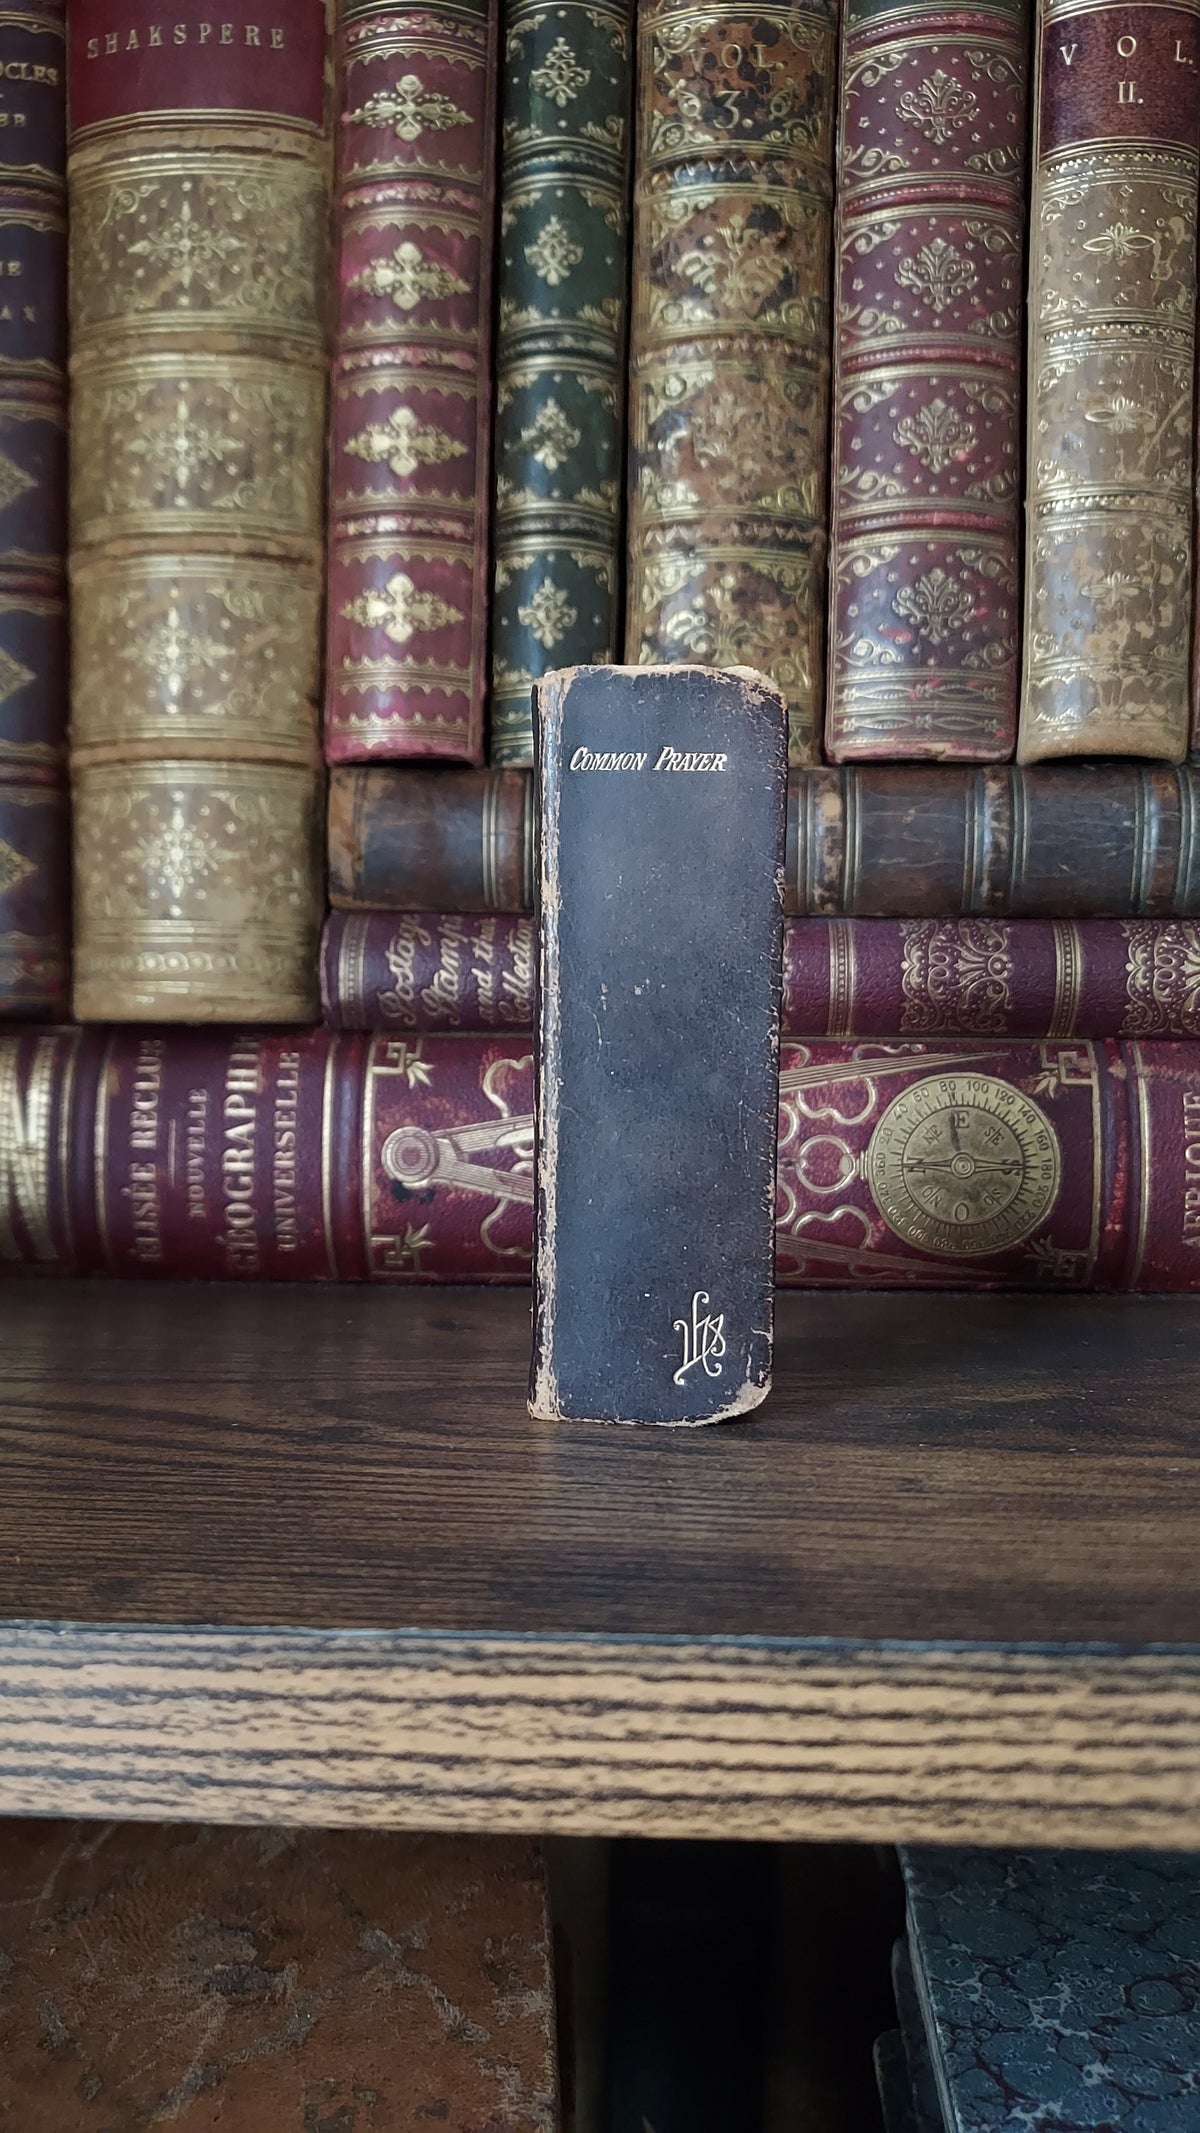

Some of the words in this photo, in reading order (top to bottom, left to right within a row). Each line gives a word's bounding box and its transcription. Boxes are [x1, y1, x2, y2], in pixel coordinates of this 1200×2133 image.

[87, 24, 286, 60] SHAKSPERE
[1116, 80, 1144, 105] II.
[569, 745, 648, 771] COMMON
[652, 745, 728, 772] PRAYER
[376, 913, 432, 1026] Postage
[498, 917, 534, 1024] Collection
[470, 967, 494, 1025] and
[966, 1080, 990, 1094] 100
[995, 1089, 1016, 1106] 120
[1018, 1105, 1037, 1124] 140
[185, 1087, 208, 1219] NOUVELLE
[272, 1051, 301, 1254] UNIVERSELLE
[1040, 1158, 1054, 1181] 180
